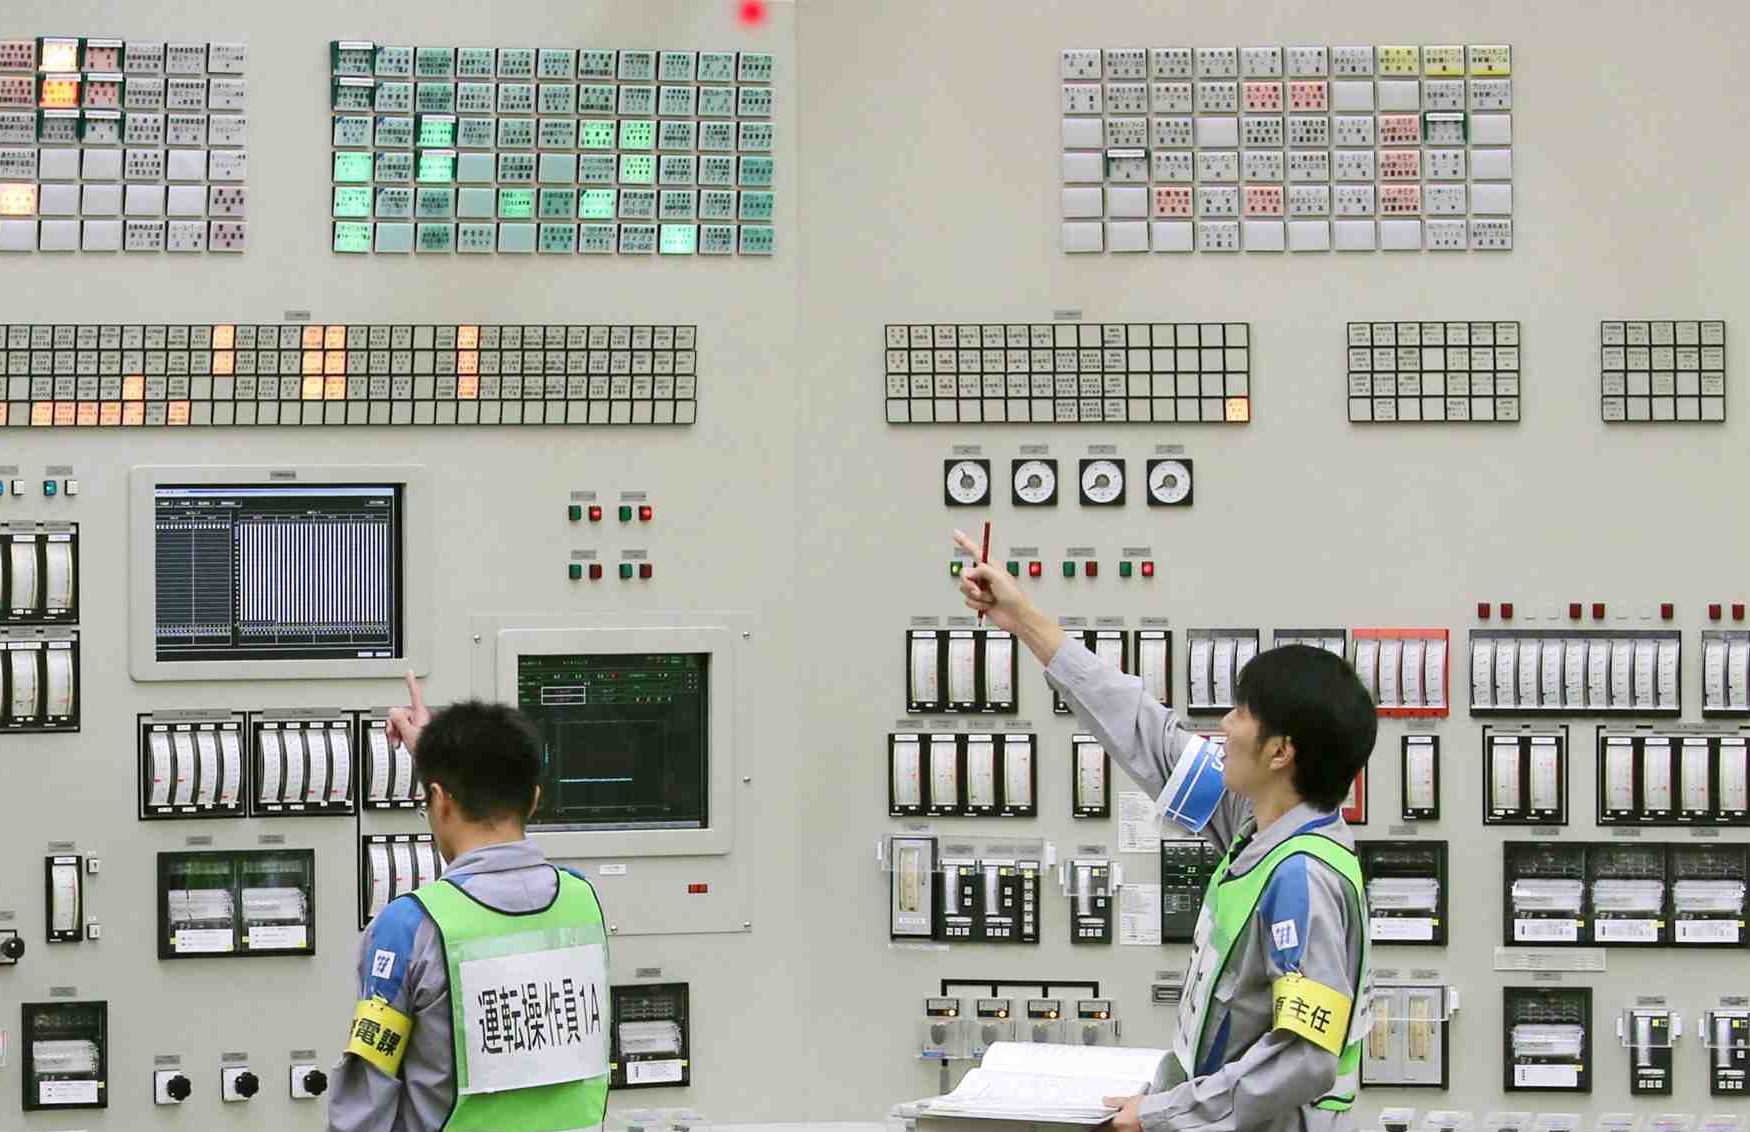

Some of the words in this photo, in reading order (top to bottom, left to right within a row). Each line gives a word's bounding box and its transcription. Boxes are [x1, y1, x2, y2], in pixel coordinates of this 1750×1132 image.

[350, 1018, 402, 1056] 電課
[478, 980, 601, 1055] 運転操作員1A
